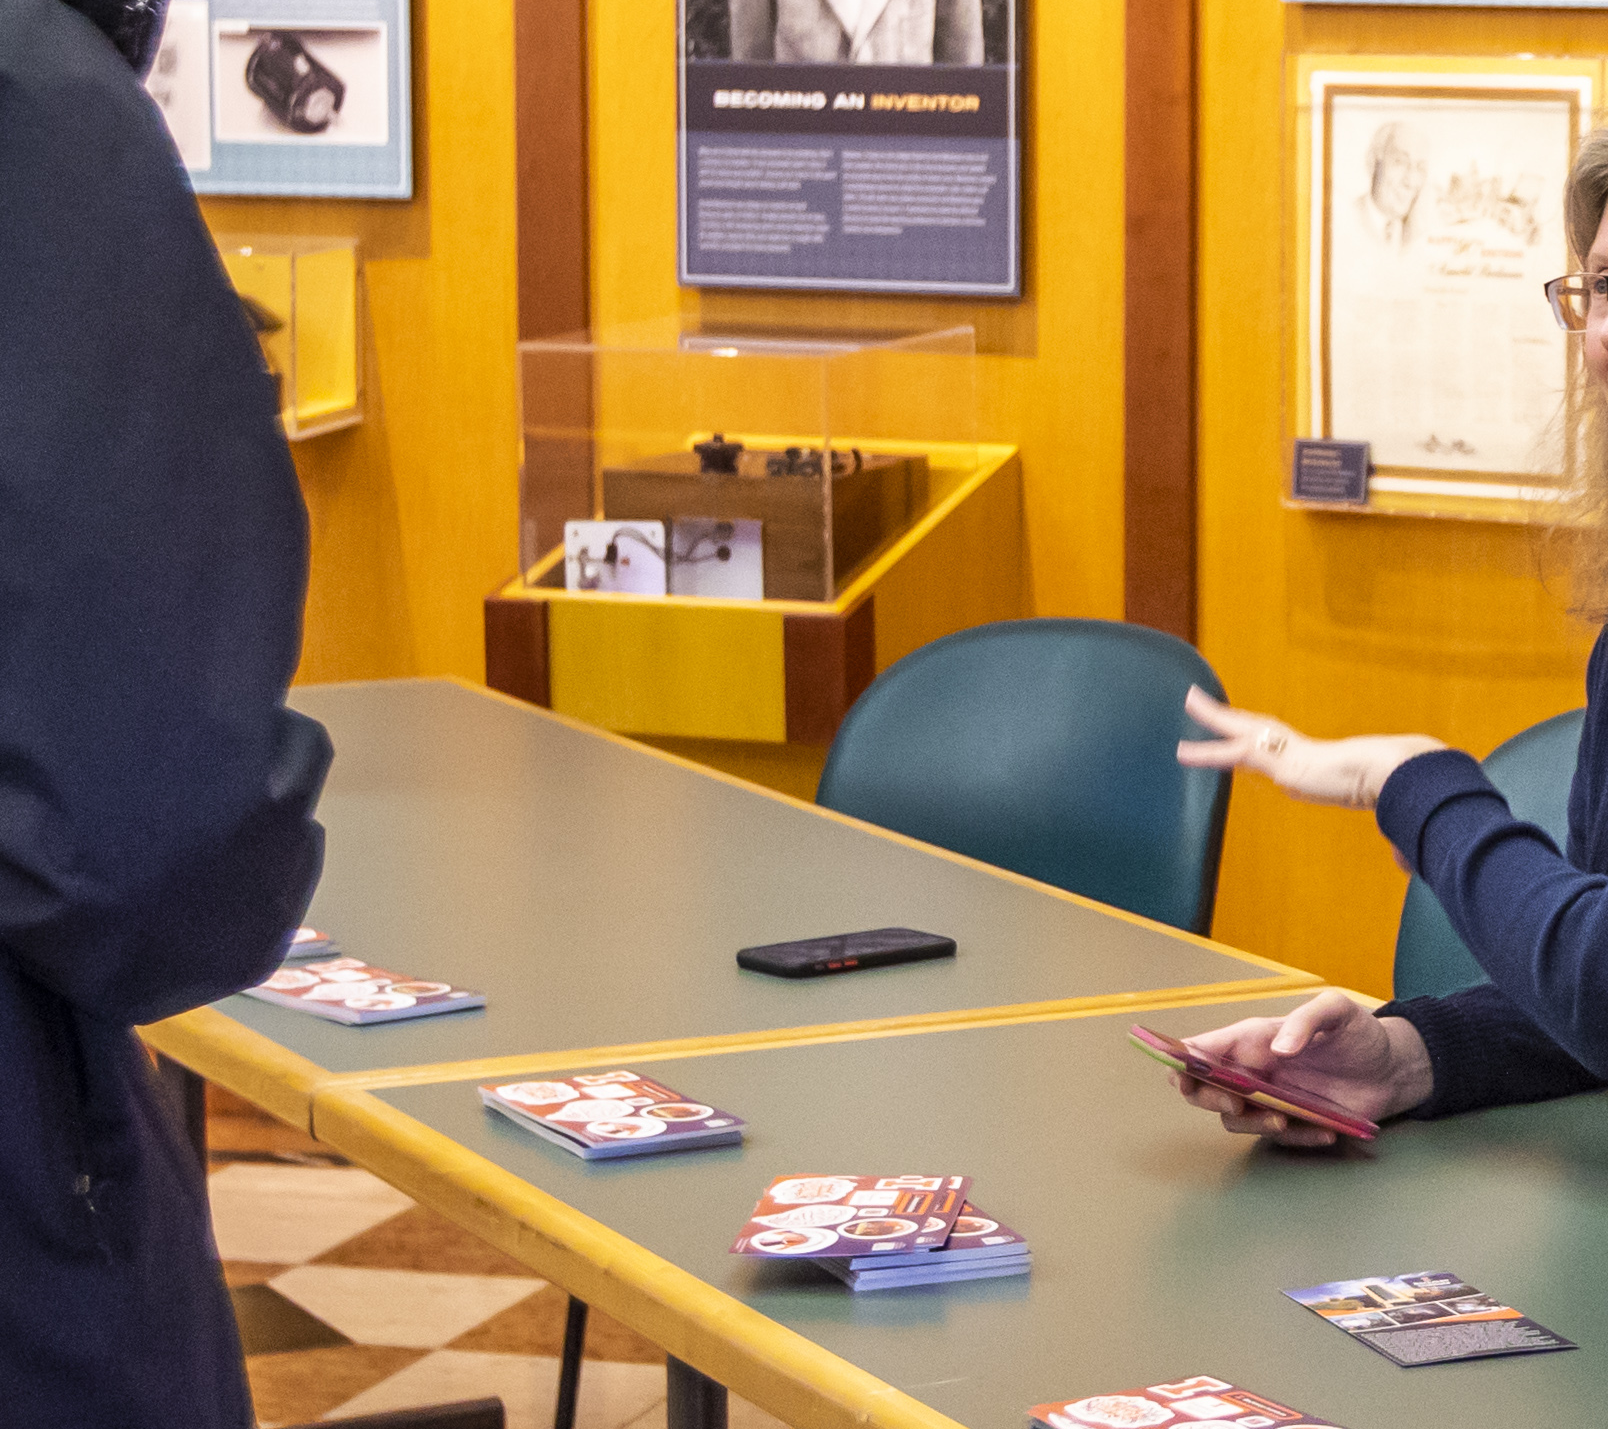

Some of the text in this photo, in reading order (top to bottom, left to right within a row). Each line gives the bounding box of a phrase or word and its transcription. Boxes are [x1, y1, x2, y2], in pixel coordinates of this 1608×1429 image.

[712, 89, 980, 112] BECOMING AN INVENTOR
